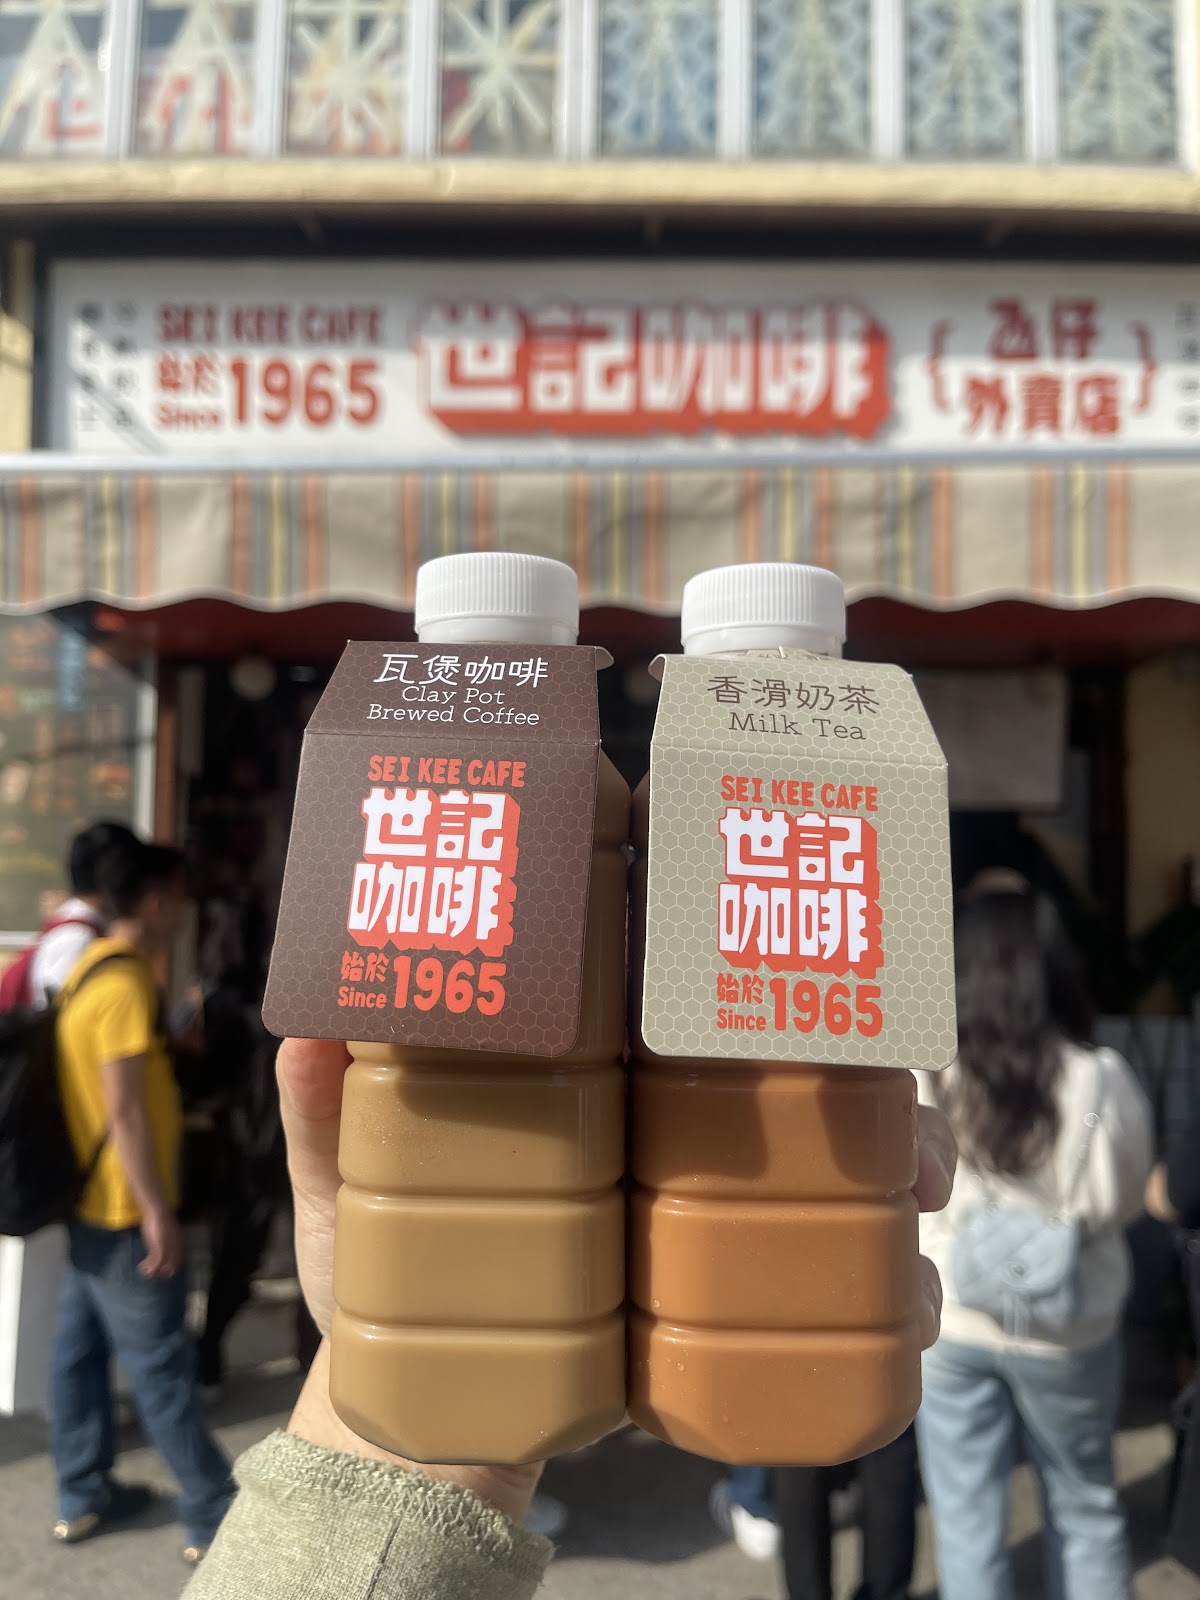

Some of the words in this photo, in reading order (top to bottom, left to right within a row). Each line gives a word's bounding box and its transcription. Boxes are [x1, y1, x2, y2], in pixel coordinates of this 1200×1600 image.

[158, 304, 219, 343] SEI
[231, 304, 291, 343] KEE
[303, 304, 382, 344] CAFE
[420, 298, 882, 430] 世記咖啡
[229, 355, 381, 428] 1965
[372, 653, 549, 688] 瓦煲咖啡
[366, 703, 455, 723] Brewed
[462, 706, 540, 726] Coffee
[401, 685, 457, 705] Clay
[463, 687, 506, 705] Pot
[706, 675, 880, 715] 香滑奶茶
[728, 711, 803, 736] Milk
[811, 718, 867, 741] Tea
[368, 754, 412, 782] SEI
[417, 757, 462, 785] KEE
[466, 759, 527, 788] CAFE
[720, 774, 763, 803] SEI
[771, 778, 815, 807] KEE
[820, 782, 879, 812] CAFE
[361, 786, 512, 862] 世記
[718, 806, 868, 884] 世記
[347, 861, 506, 942] 咖啡
[717, 881, 873, 964] 咖啡
[337, 986, 387, 1009] Since
[339, 950, 390, 983] 始於
[393, 955, 507, 1016] 1965
[716, 972, 764, 1004] 始於
[769, 977, 884, 1037] 1965
[716, 1008, 767, 1031] Since
